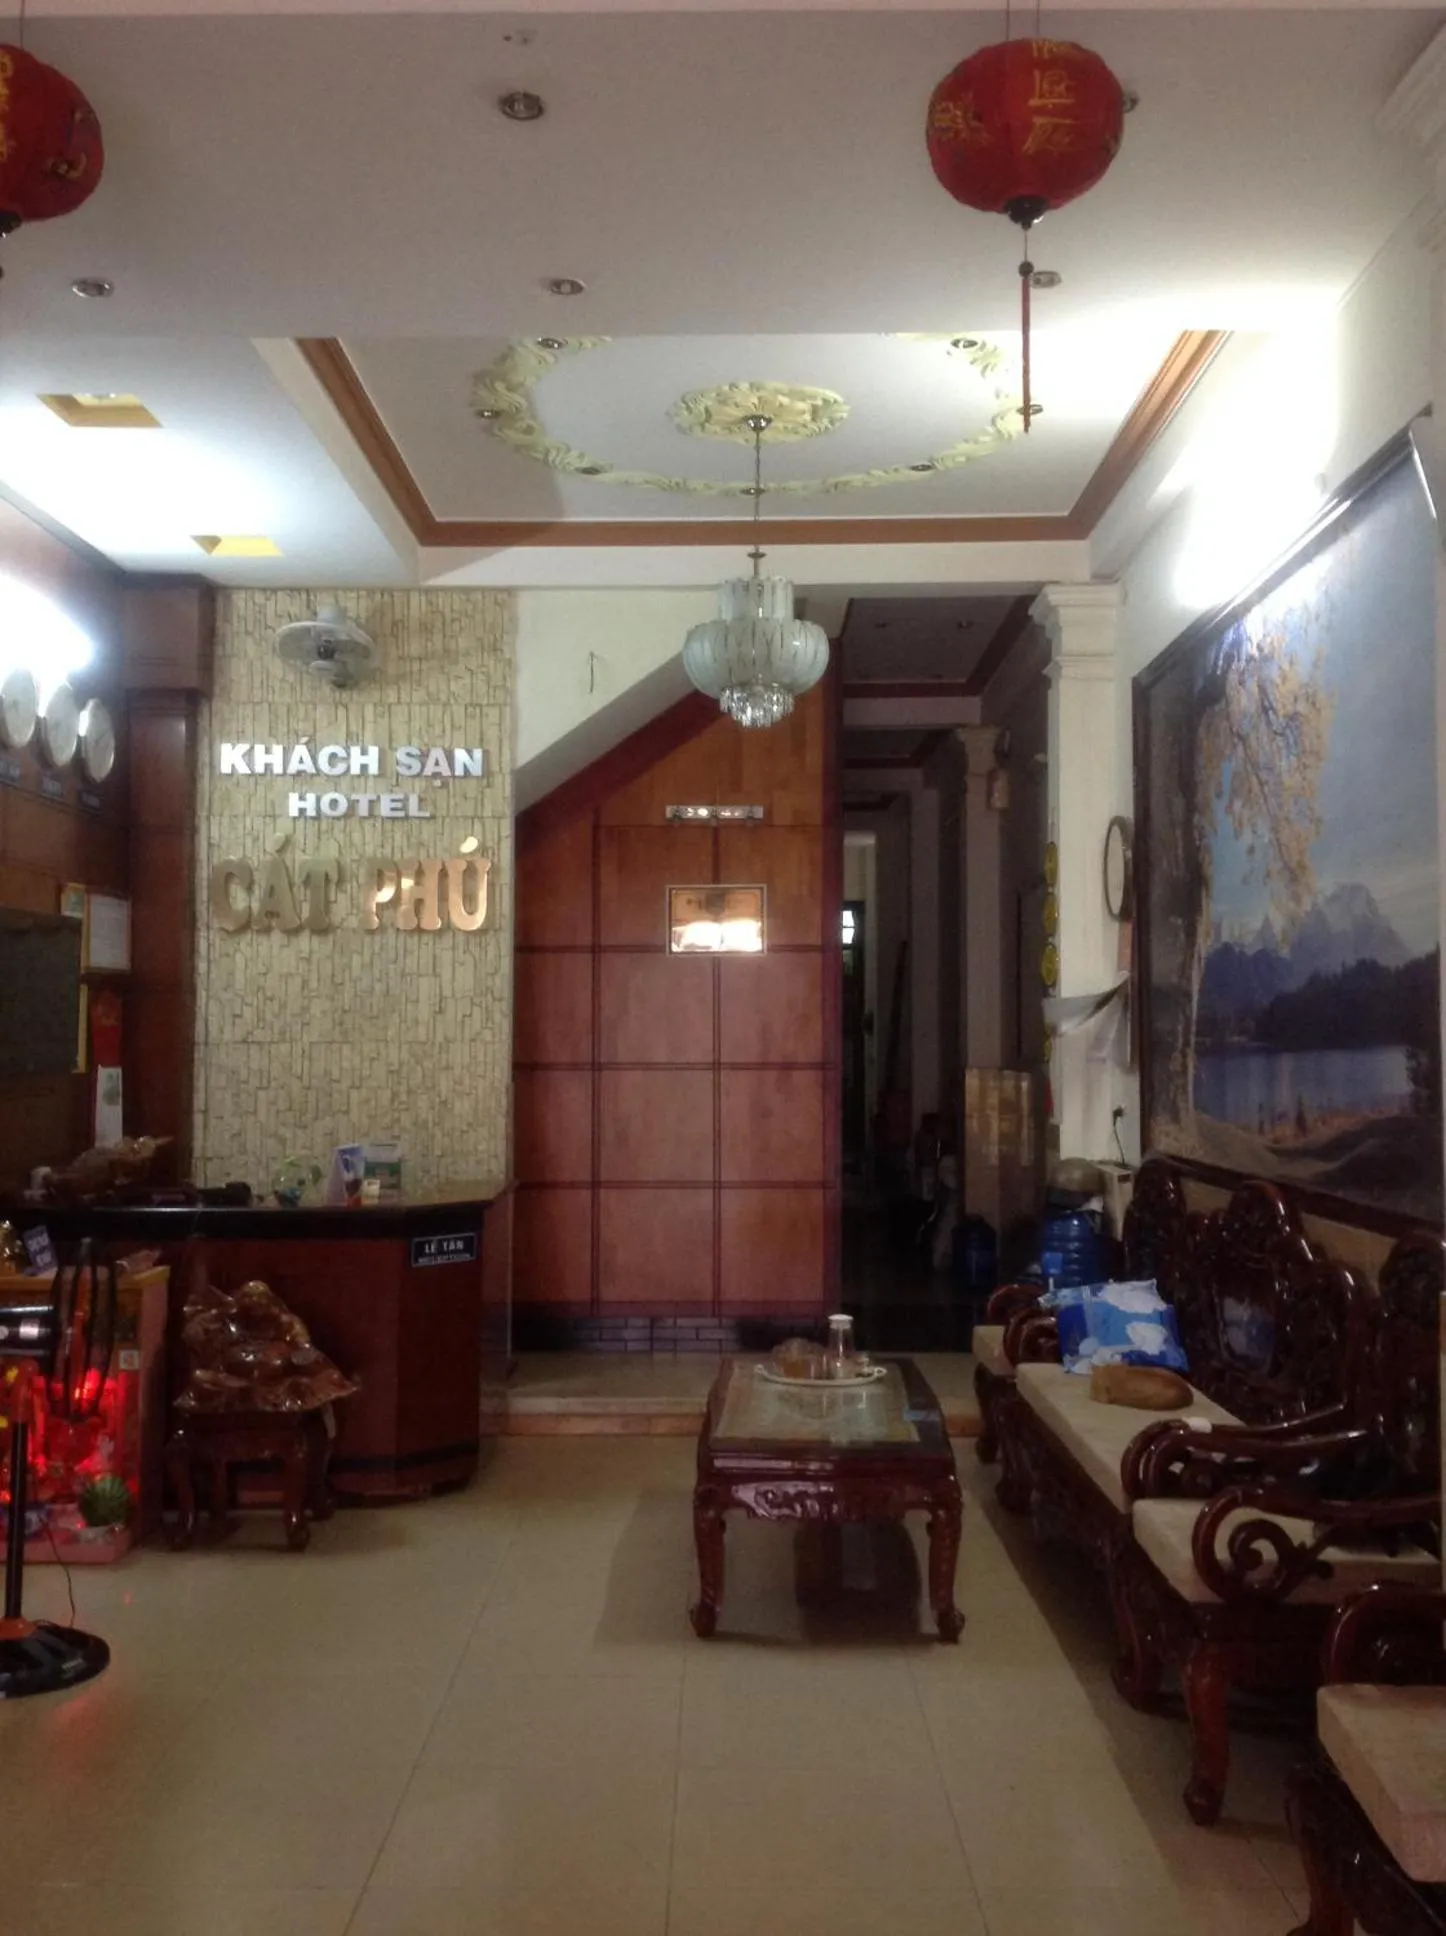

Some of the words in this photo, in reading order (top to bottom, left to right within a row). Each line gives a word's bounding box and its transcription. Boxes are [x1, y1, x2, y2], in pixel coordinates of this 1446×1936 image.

[219, 736, 381, 776] KHÁCH
[395, 747, 485, 787] SẠN
[287, 791, 433, 818] HOTEL
[210, 831, 341, 932] CÁT
[362, 835, 492, 932] PHÚ
